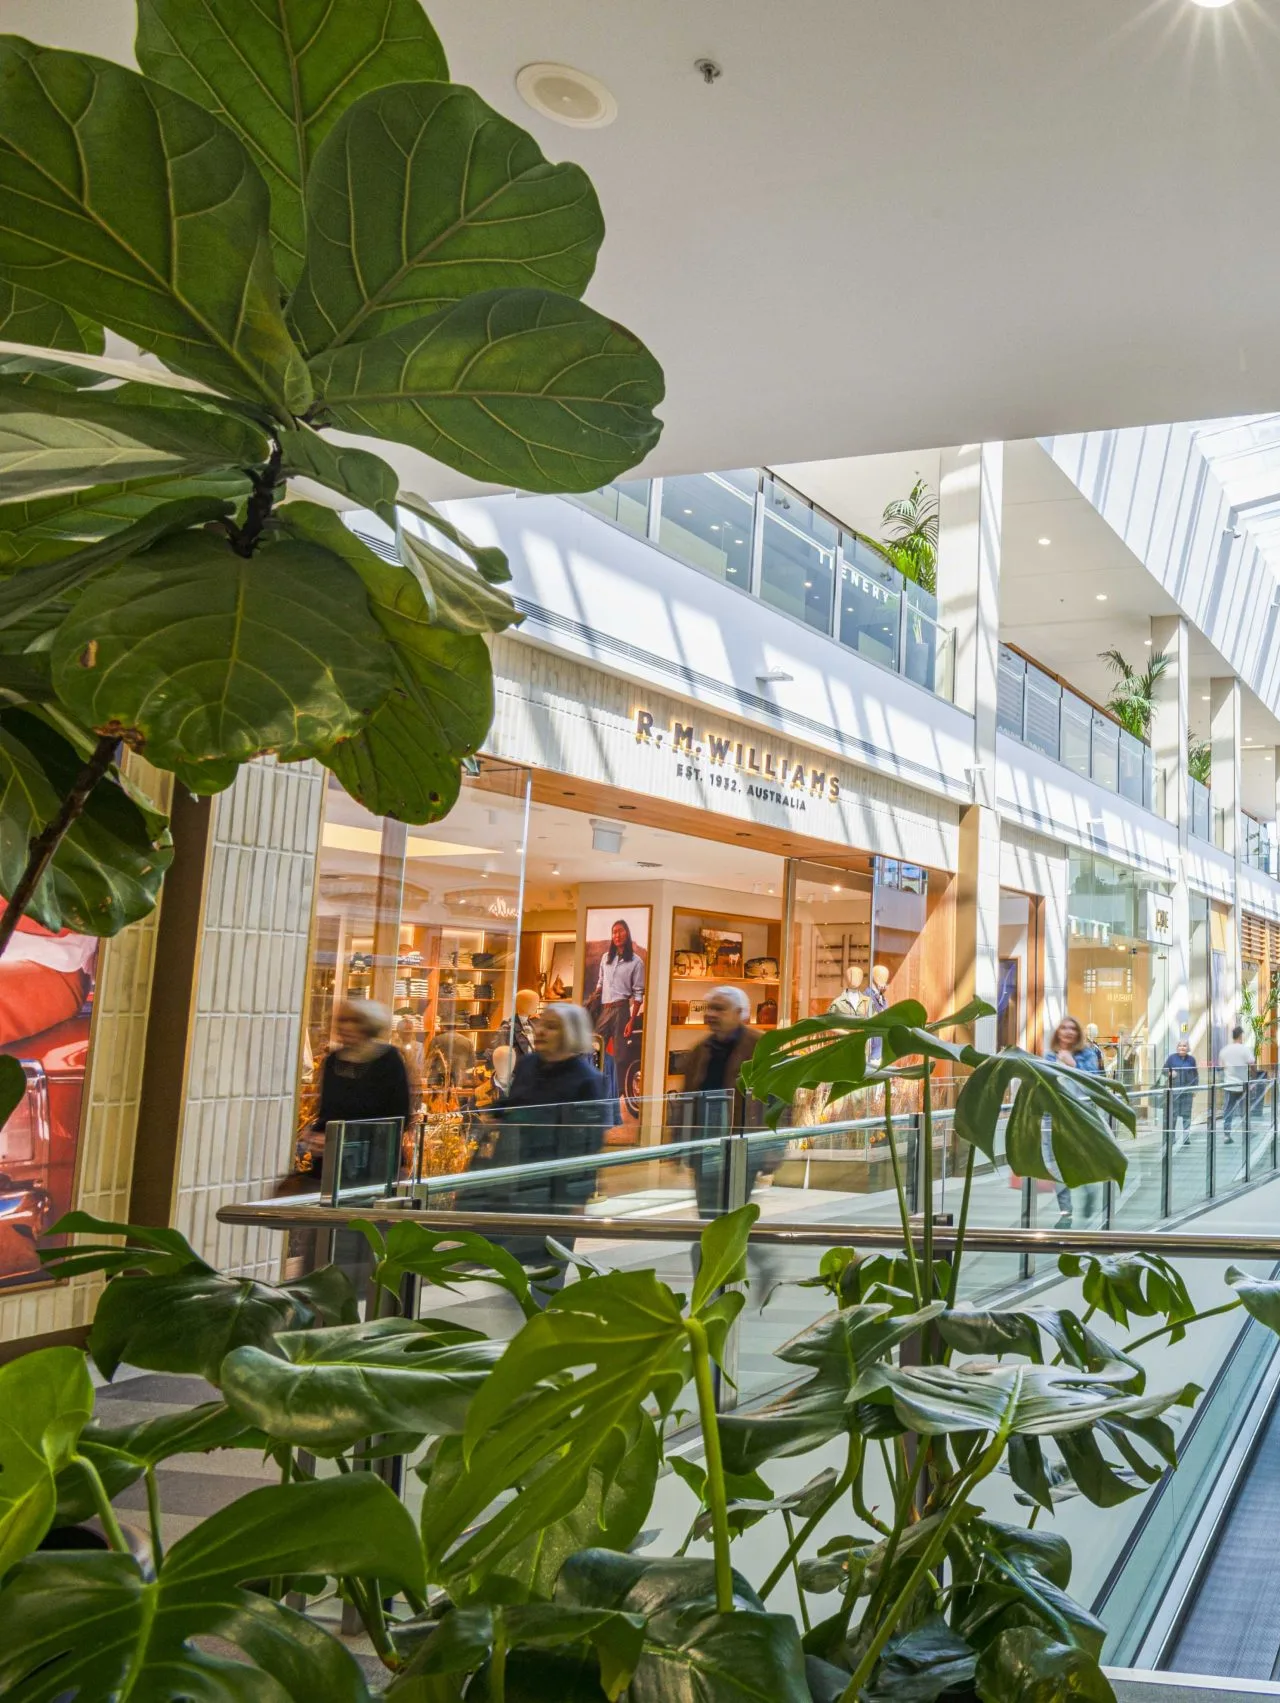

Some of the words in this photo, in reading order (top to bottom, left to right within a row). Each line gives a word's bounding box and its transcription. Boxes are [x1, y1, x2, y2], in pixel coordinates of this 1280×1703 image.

[636, 711, 663, 740] R.
[674, 722, 702, 753] M.
[708, 734, 840, 797] WILLIAMS
[676, 763, 703, 782] EST.
[746, 784, 807, 811] AUSTRALIA
